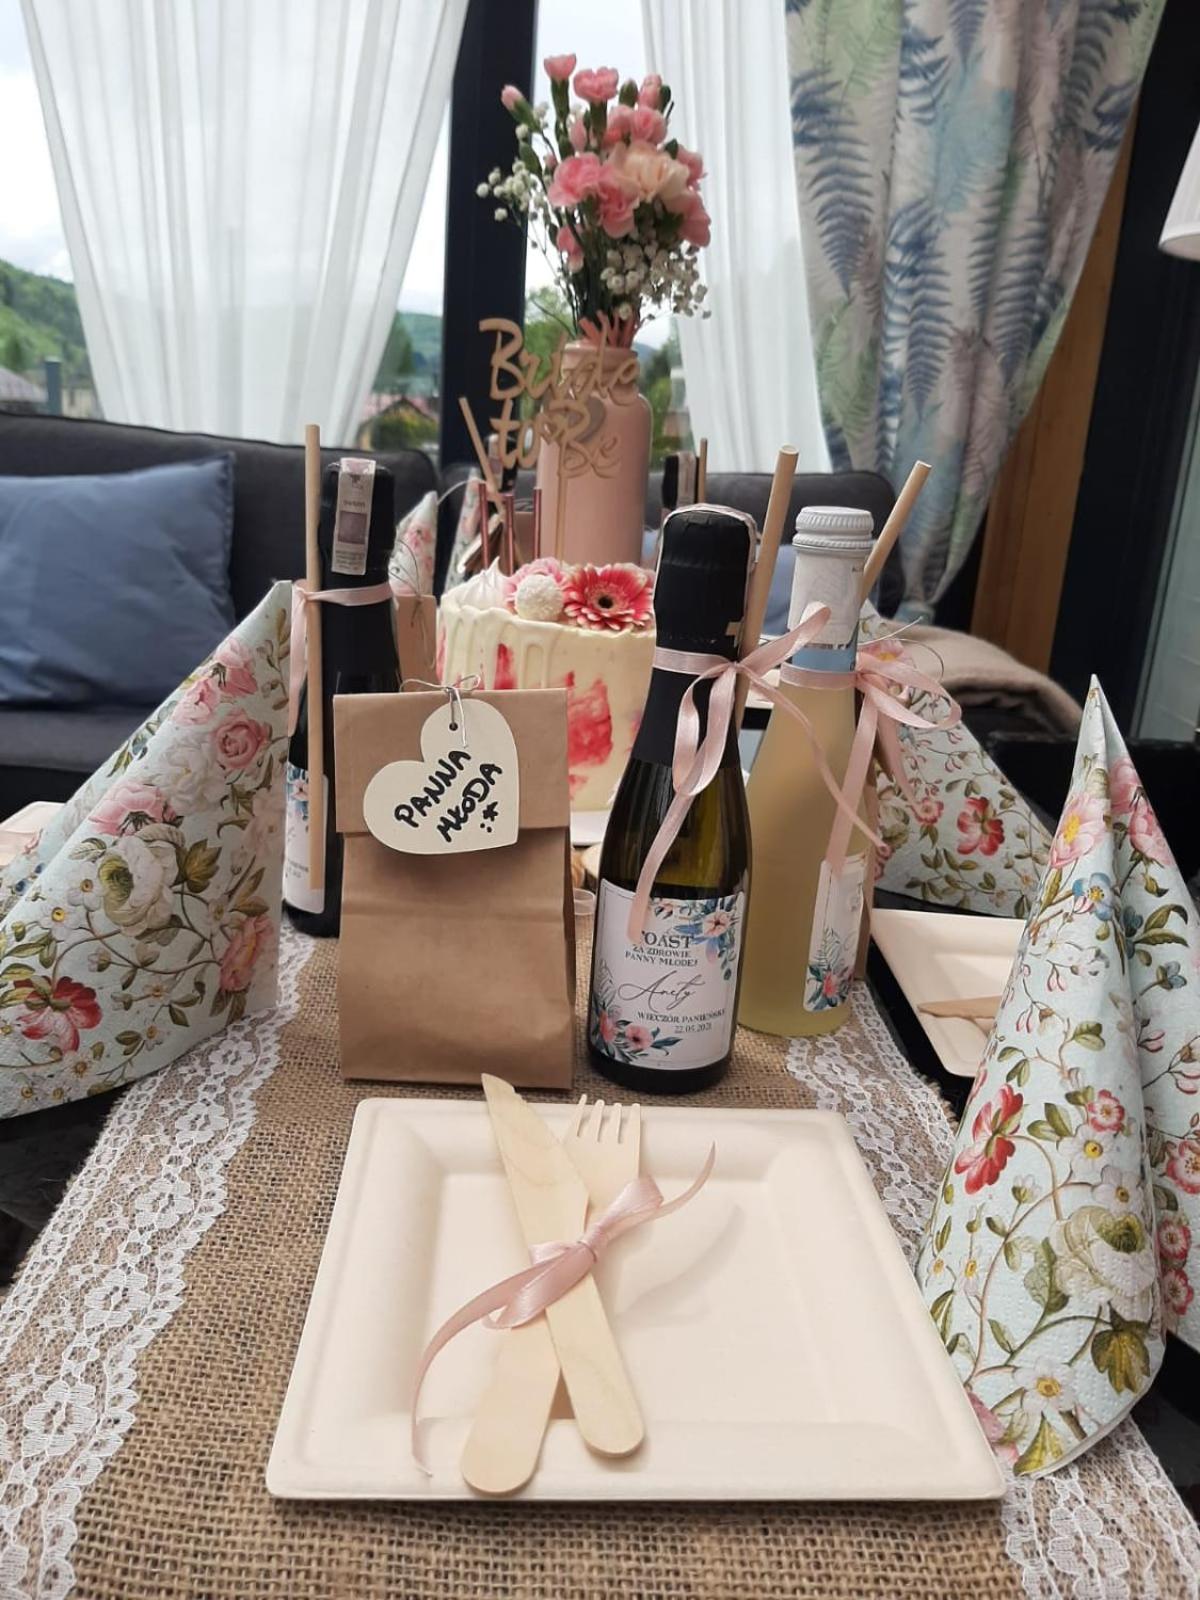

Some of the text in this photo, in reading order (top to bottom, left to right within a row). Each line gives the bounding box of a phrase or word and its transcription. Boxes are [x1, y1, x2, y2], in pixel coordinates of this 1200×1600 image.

[479, 313, 640, 406] Bride
[394, 750, 471, 828] PANNA
[641, 930, 694, 949] OAST
[625, 951, 656, 965] PANNY
[647, 947, 692, 958] ZDROWIE
